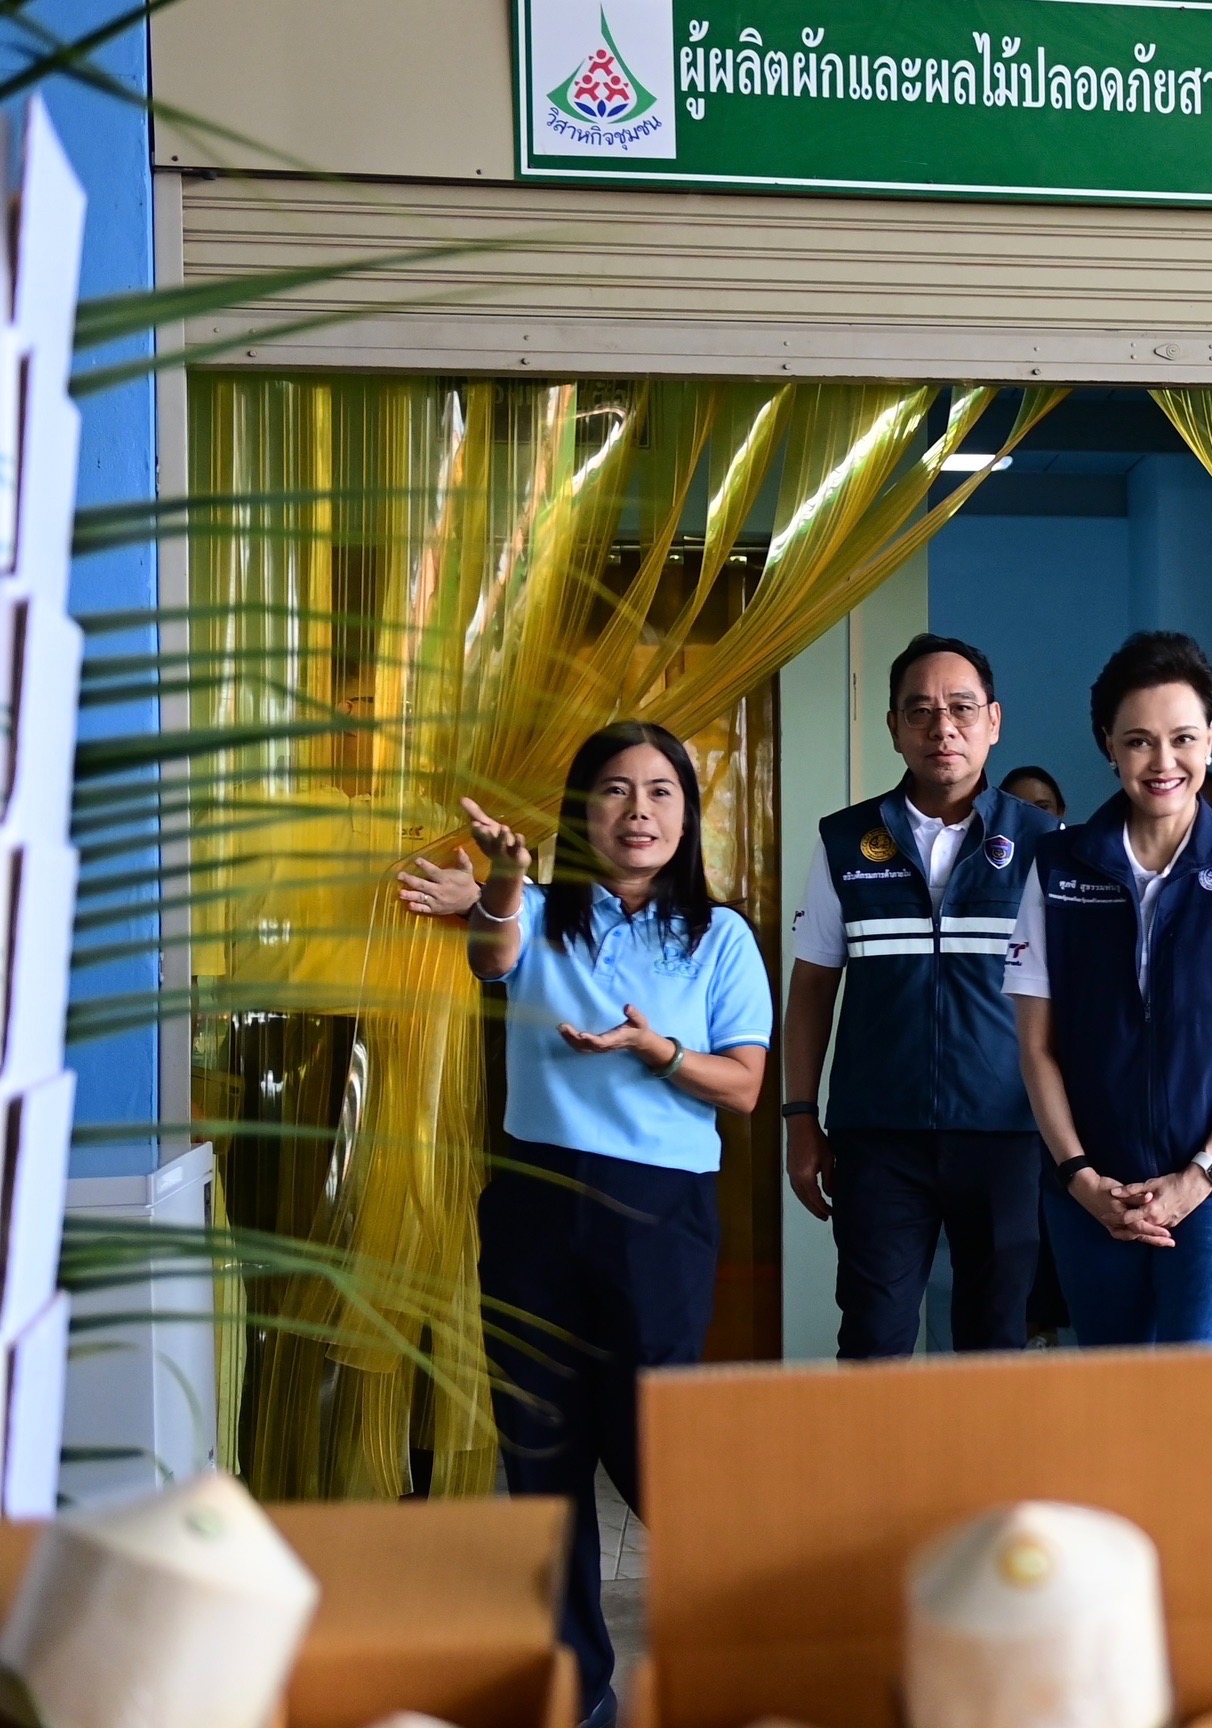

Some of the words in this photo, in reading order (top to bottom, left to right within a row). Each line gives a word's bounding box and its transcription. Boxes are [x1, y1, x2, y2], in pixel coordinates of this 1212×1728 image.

[546, 106, 662, 150] วิสาหกิจชุมชน
